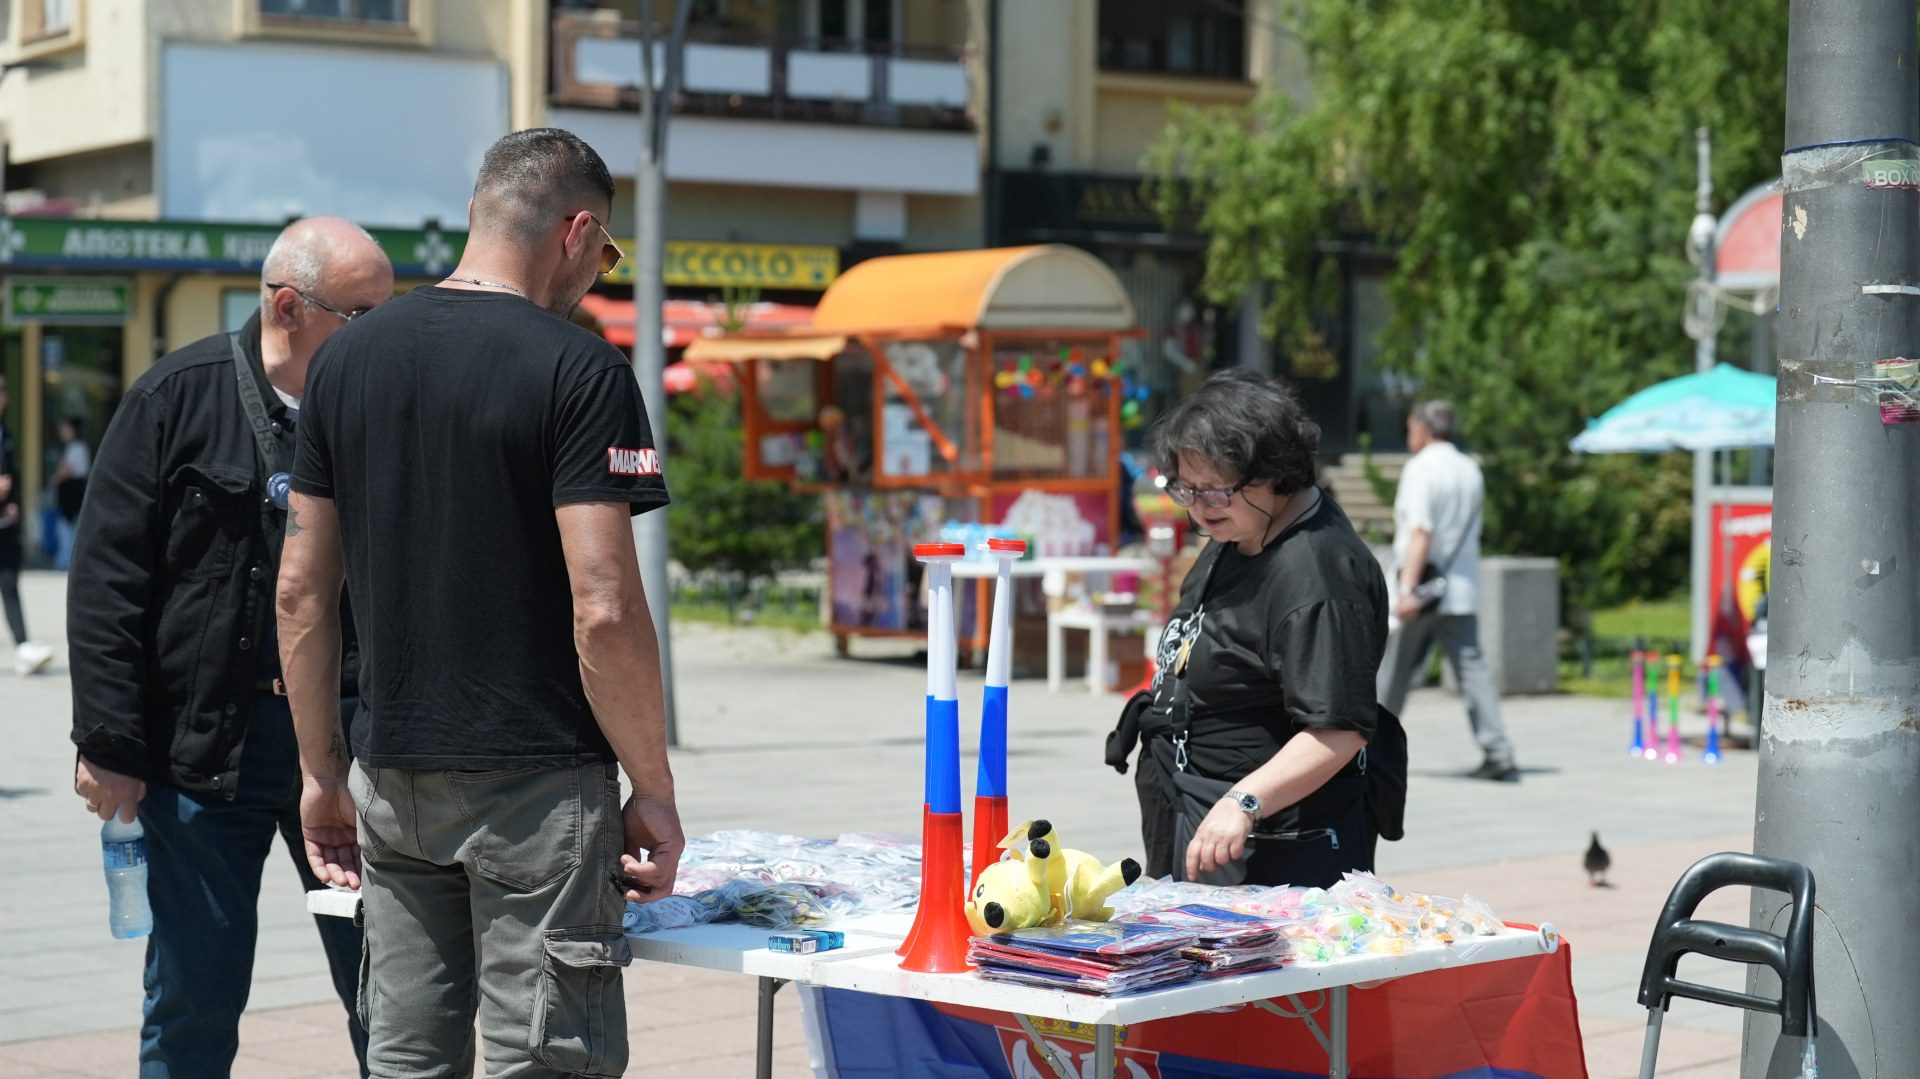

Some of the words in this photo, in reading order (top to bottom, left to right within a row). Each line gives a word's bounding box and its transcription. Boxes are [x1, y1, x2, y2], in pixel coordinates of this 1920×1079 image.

[64, 228, 209, 260] АПОТЕКА
[667, 245, 795, 279] ICCOLO
[610, 448, 661, 474] MARVE
